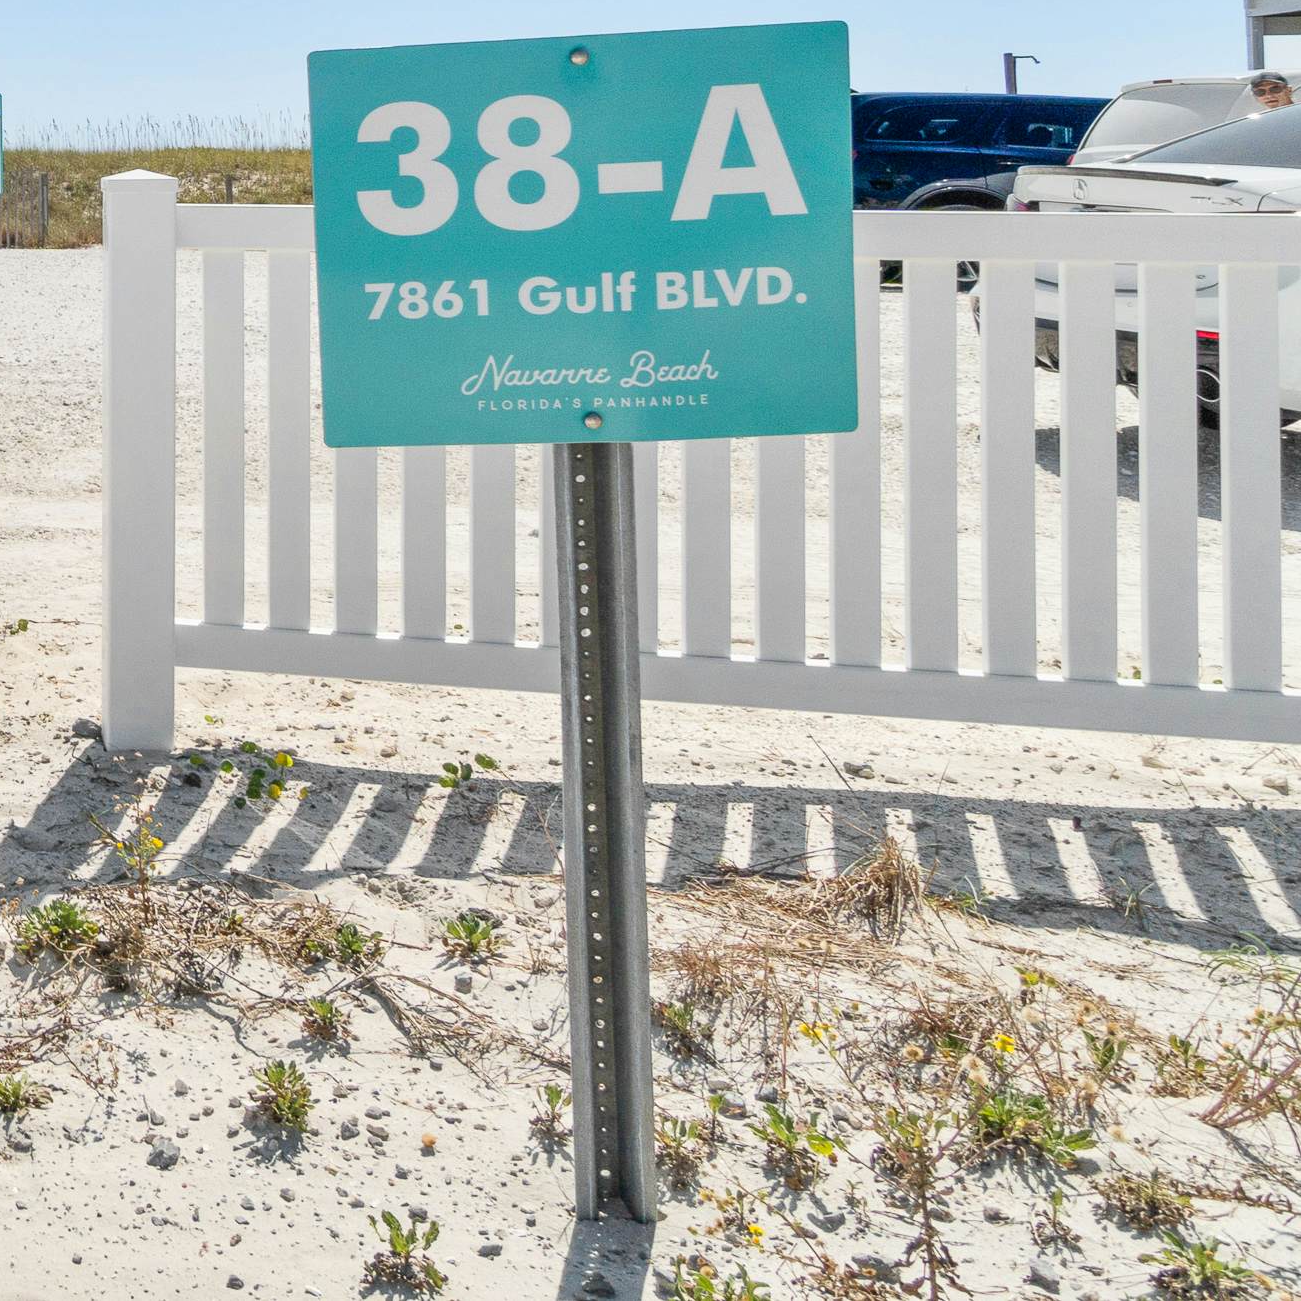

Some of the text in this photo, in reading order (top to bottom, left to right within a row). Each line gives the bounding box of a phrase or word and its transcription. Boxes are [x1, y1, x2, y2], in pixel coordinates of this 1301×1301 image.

[356, 83, 809, 237] 38-A
[364, 266, 808, 320] 7861 Gulf BLVD.
[460, 349, 718, 395] Navarre Beach
[478, 394, 710, 411] FLORIDA'S PANHANDLE
